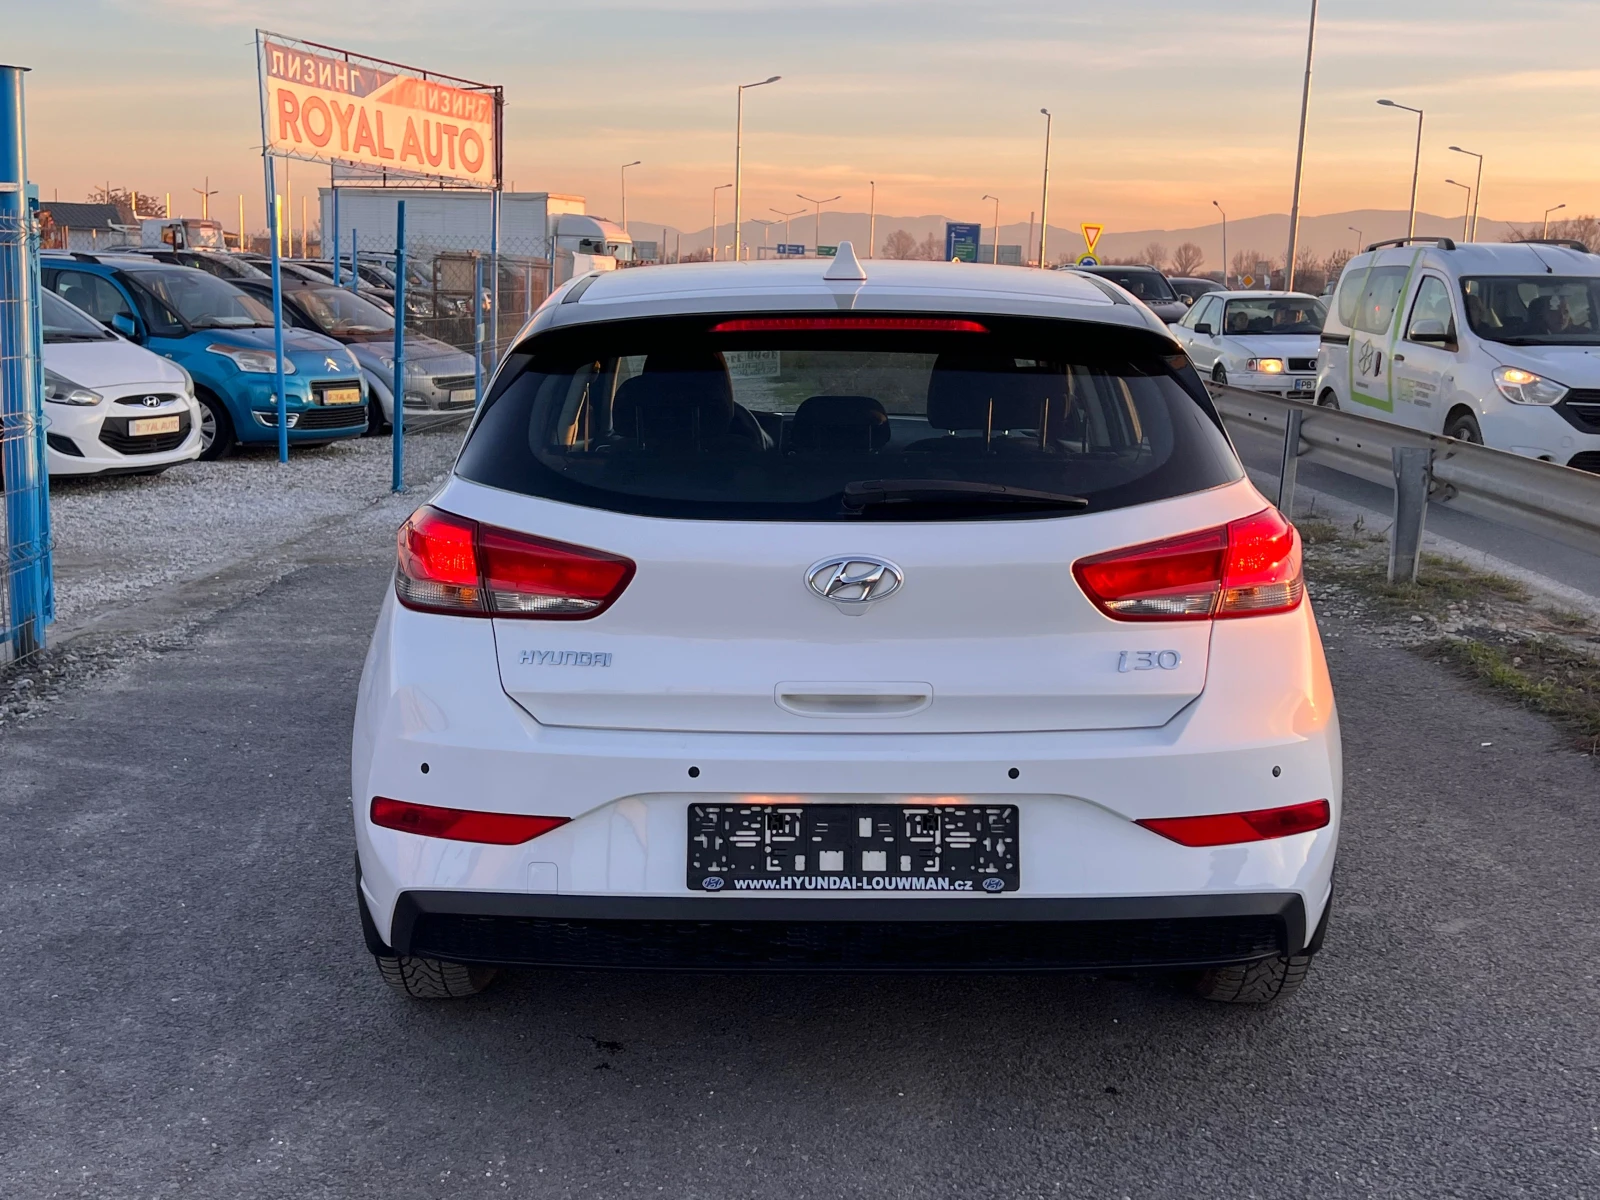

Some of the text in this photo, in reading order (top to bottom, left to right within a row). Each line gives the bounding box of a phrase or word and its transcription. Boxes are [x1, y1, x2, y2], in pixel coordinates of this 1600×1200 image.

[271, 50, 360, 93] ЛИЗИНГ
[277, 88, 485, 174] ROYAL AUTO
[519, 649, 612, 667] HYUNDAI
[734, 876, 973, 891] www.HYUNDAI-LOUWMAN.cz
